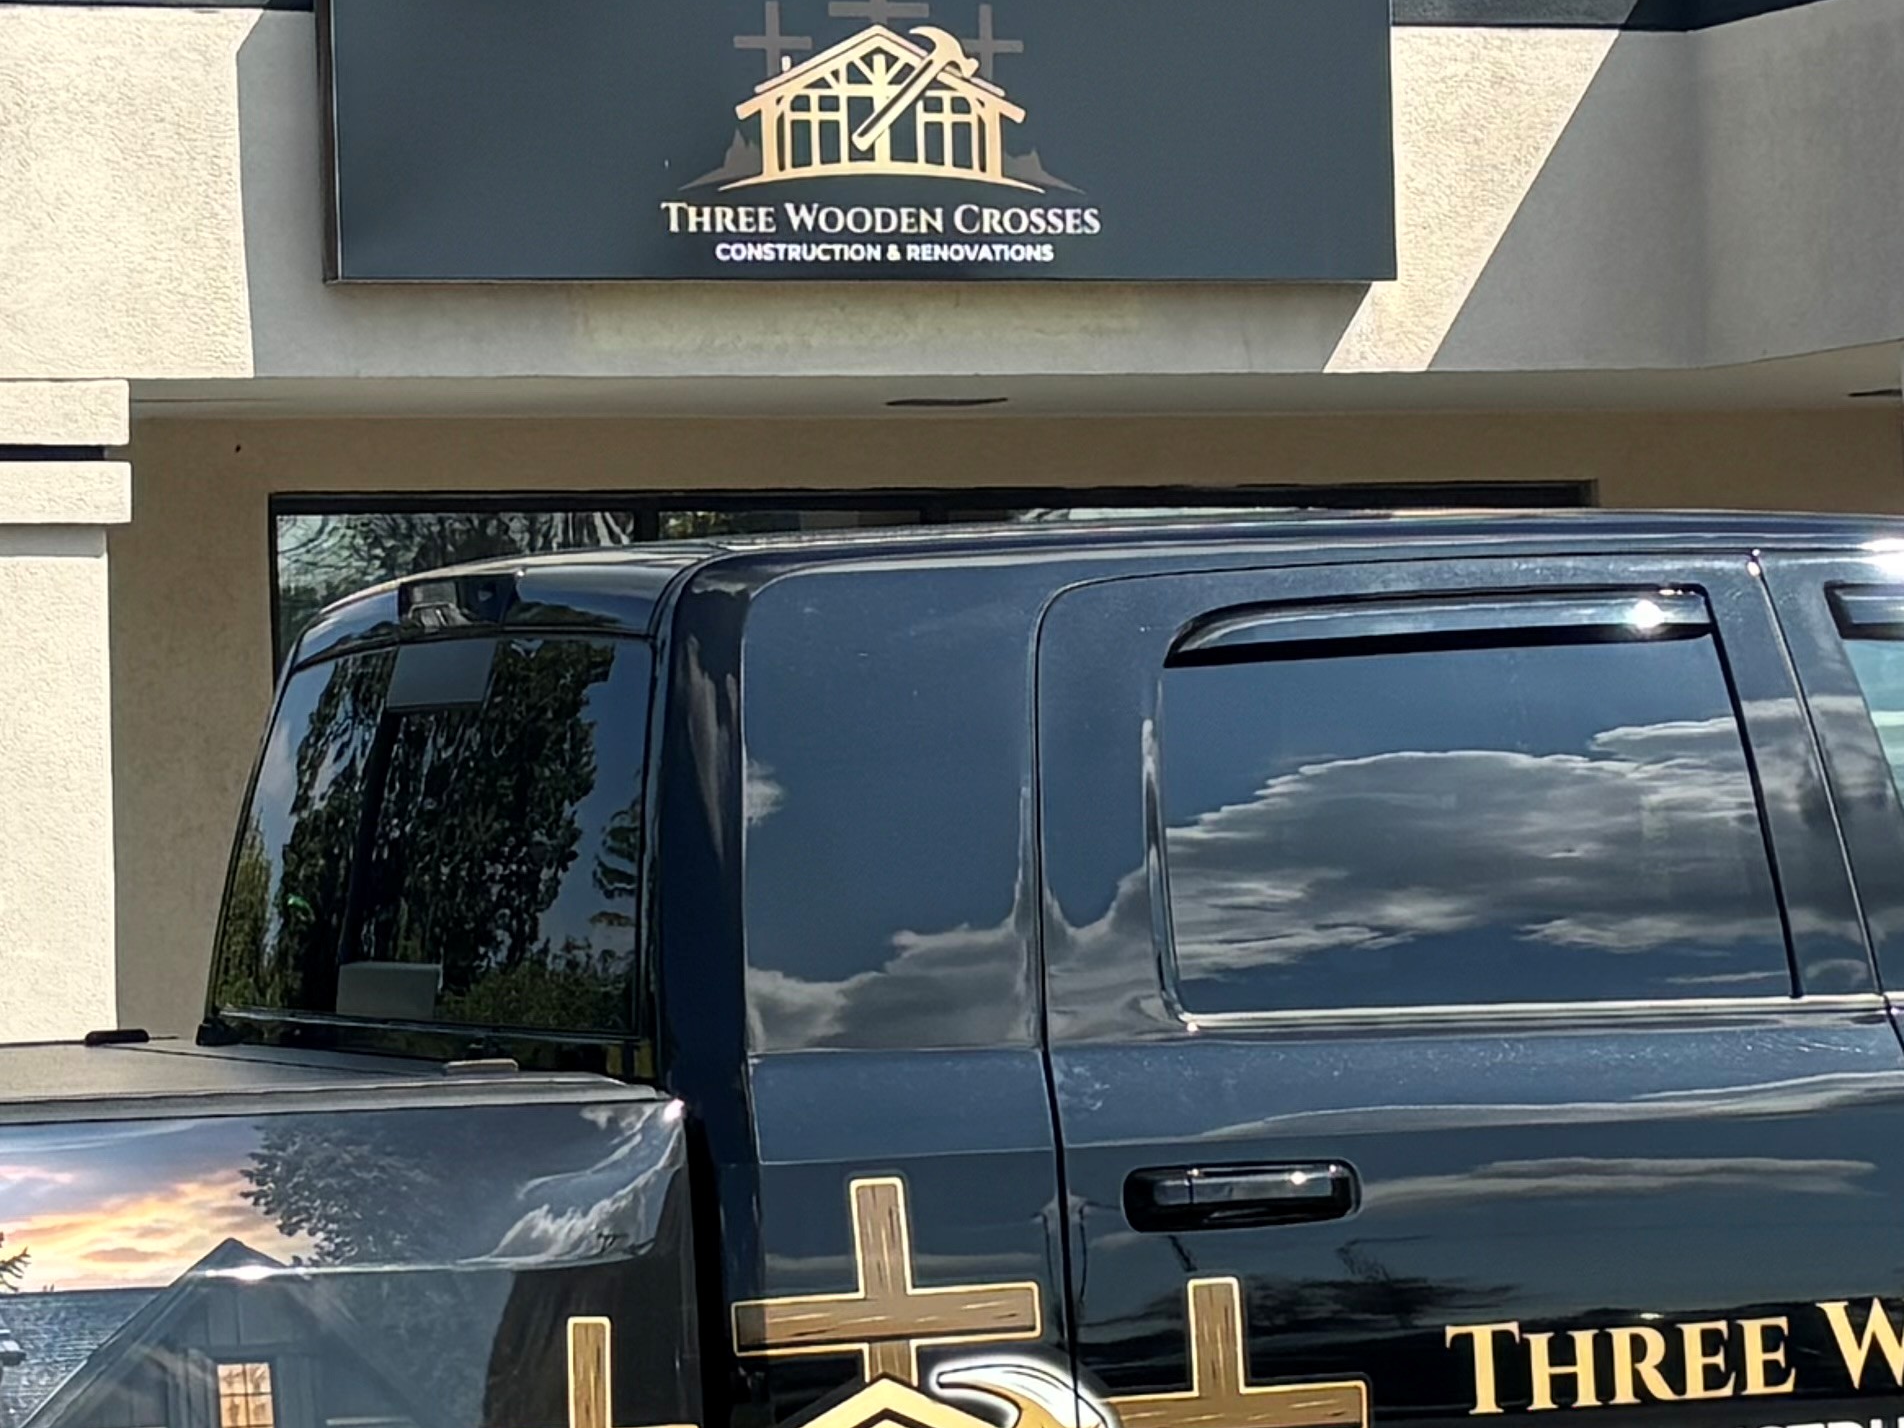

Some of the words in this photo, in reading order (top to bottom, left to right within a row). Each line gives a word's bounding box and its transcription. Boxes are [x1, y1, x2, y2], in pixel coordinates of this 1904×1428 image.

[661, 202, 777, 233] THREE
[785, 202, 944, 234] WOODEN
[953, 204, 1102, 235] CROSSES
[715, 243, 881, 262] CONSTRUCTION
[887, 244, 899, 262] &
[906, 243, 1055, 263] RENOVATIONS
[1445, 1315, 1796, 1415] THREE
